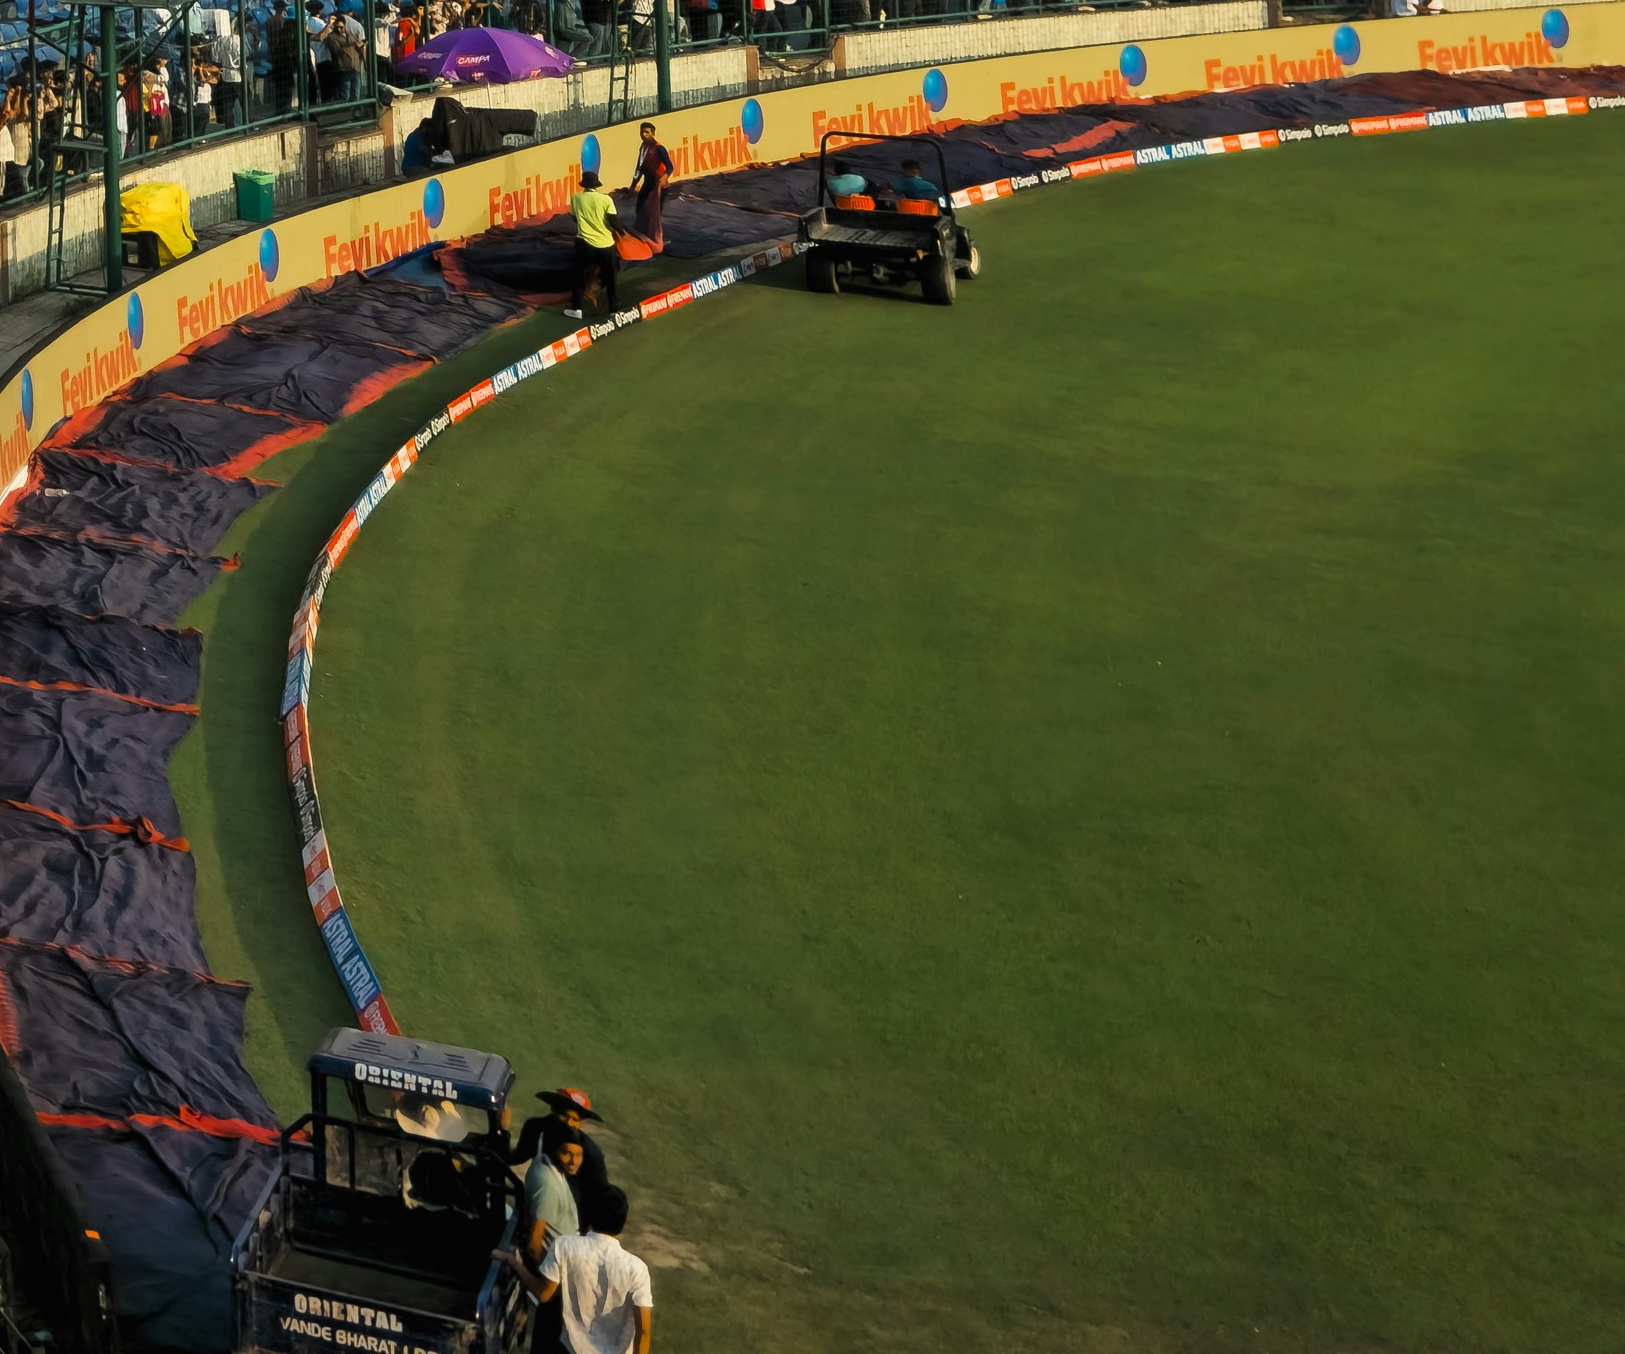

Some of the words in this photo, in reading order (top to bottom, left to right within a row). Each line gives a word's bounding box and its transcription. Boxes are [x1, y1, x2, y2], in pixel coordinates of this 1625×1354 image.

[1428, 108, 1466, 126] ASTRAL
[1467, 104, 1504, 123] ASTRAL
[1136, 146, 1170, 165] ASTRAL
[1171, 140, 1206, 159] ASTRAL
[494, 367, 518, 395] ASTRAL
[517, 355, 543, 381] ASTRAL
[354, 1062, 458, 1101] ORIENTAL
[294, 1293, 403, 1333] ORIENTAL
[280, 1317, 332, 1342] VANDE
[335, 1329, 397, 1354] BHARAT
